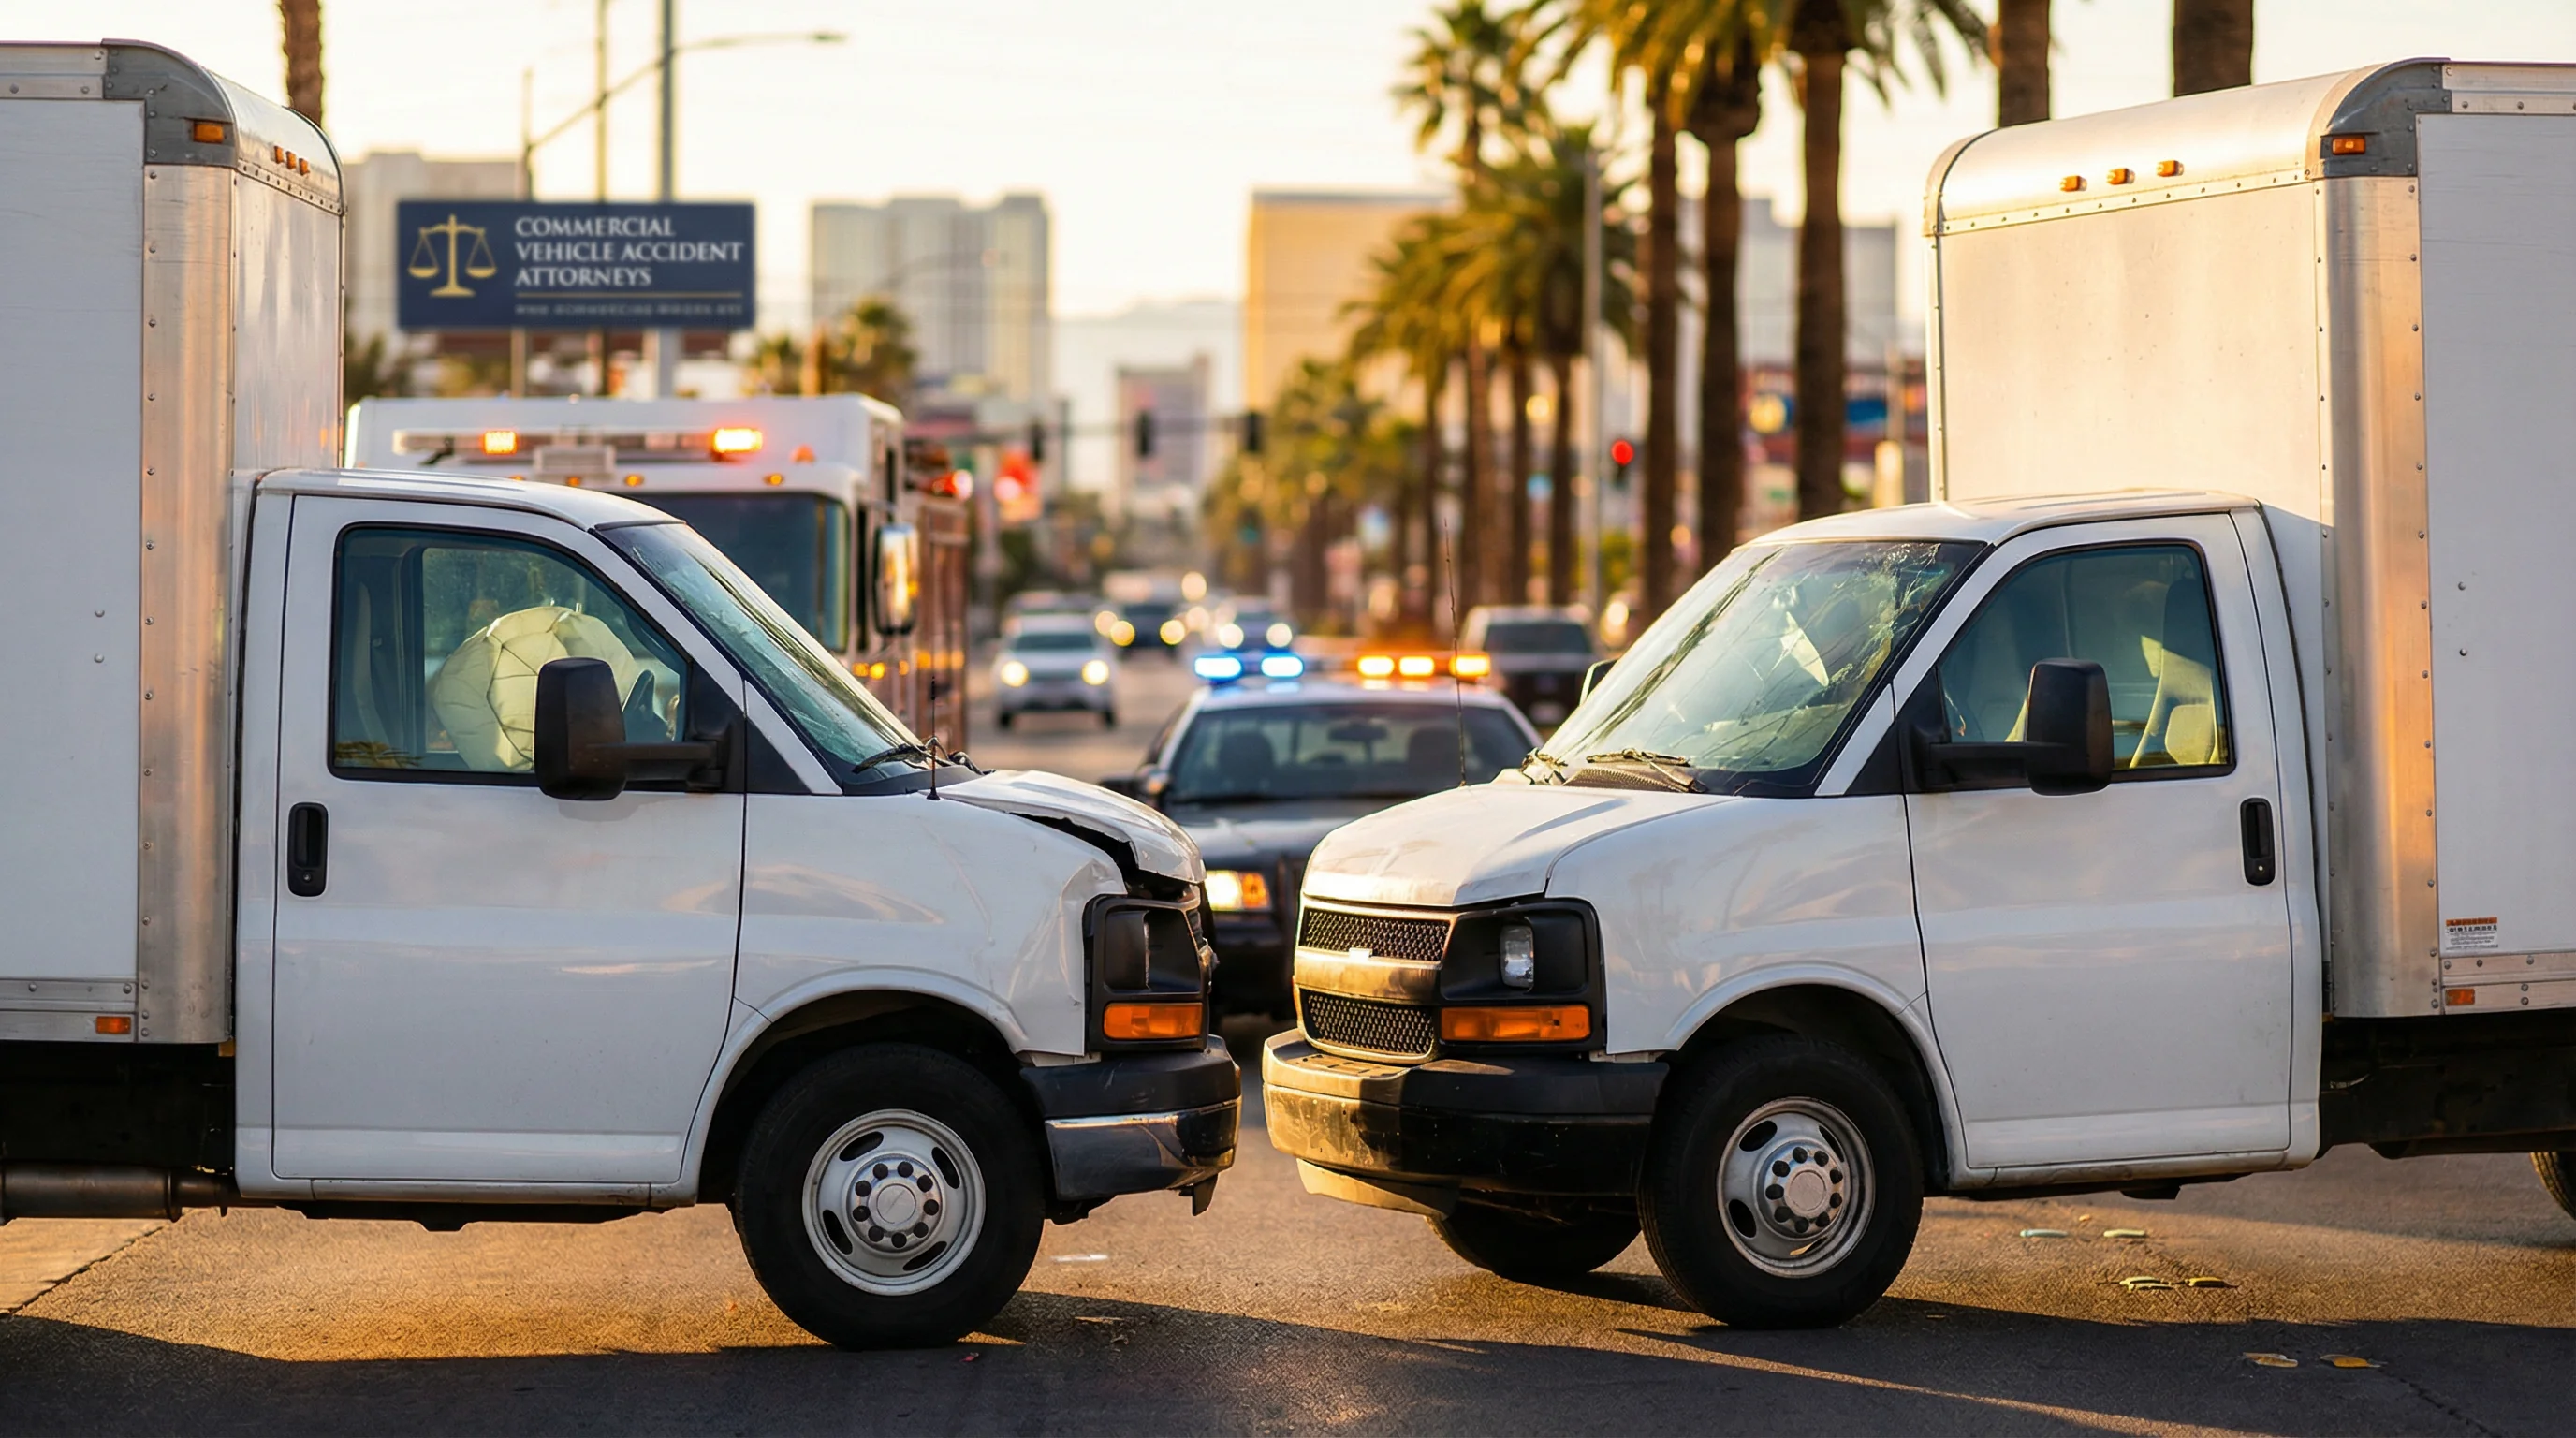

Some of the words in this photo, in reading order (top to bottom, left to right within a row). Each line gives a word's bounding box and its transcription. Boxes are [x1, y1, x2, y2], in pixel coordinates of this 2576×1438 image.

[515, 217, 675, 237] COMMERCIAL
[515, 242, 613, 261] VEHICLE
[621, 242, 743, 261] ACCIDENT
[515, 268, 652, 286] ATTORNEYS
